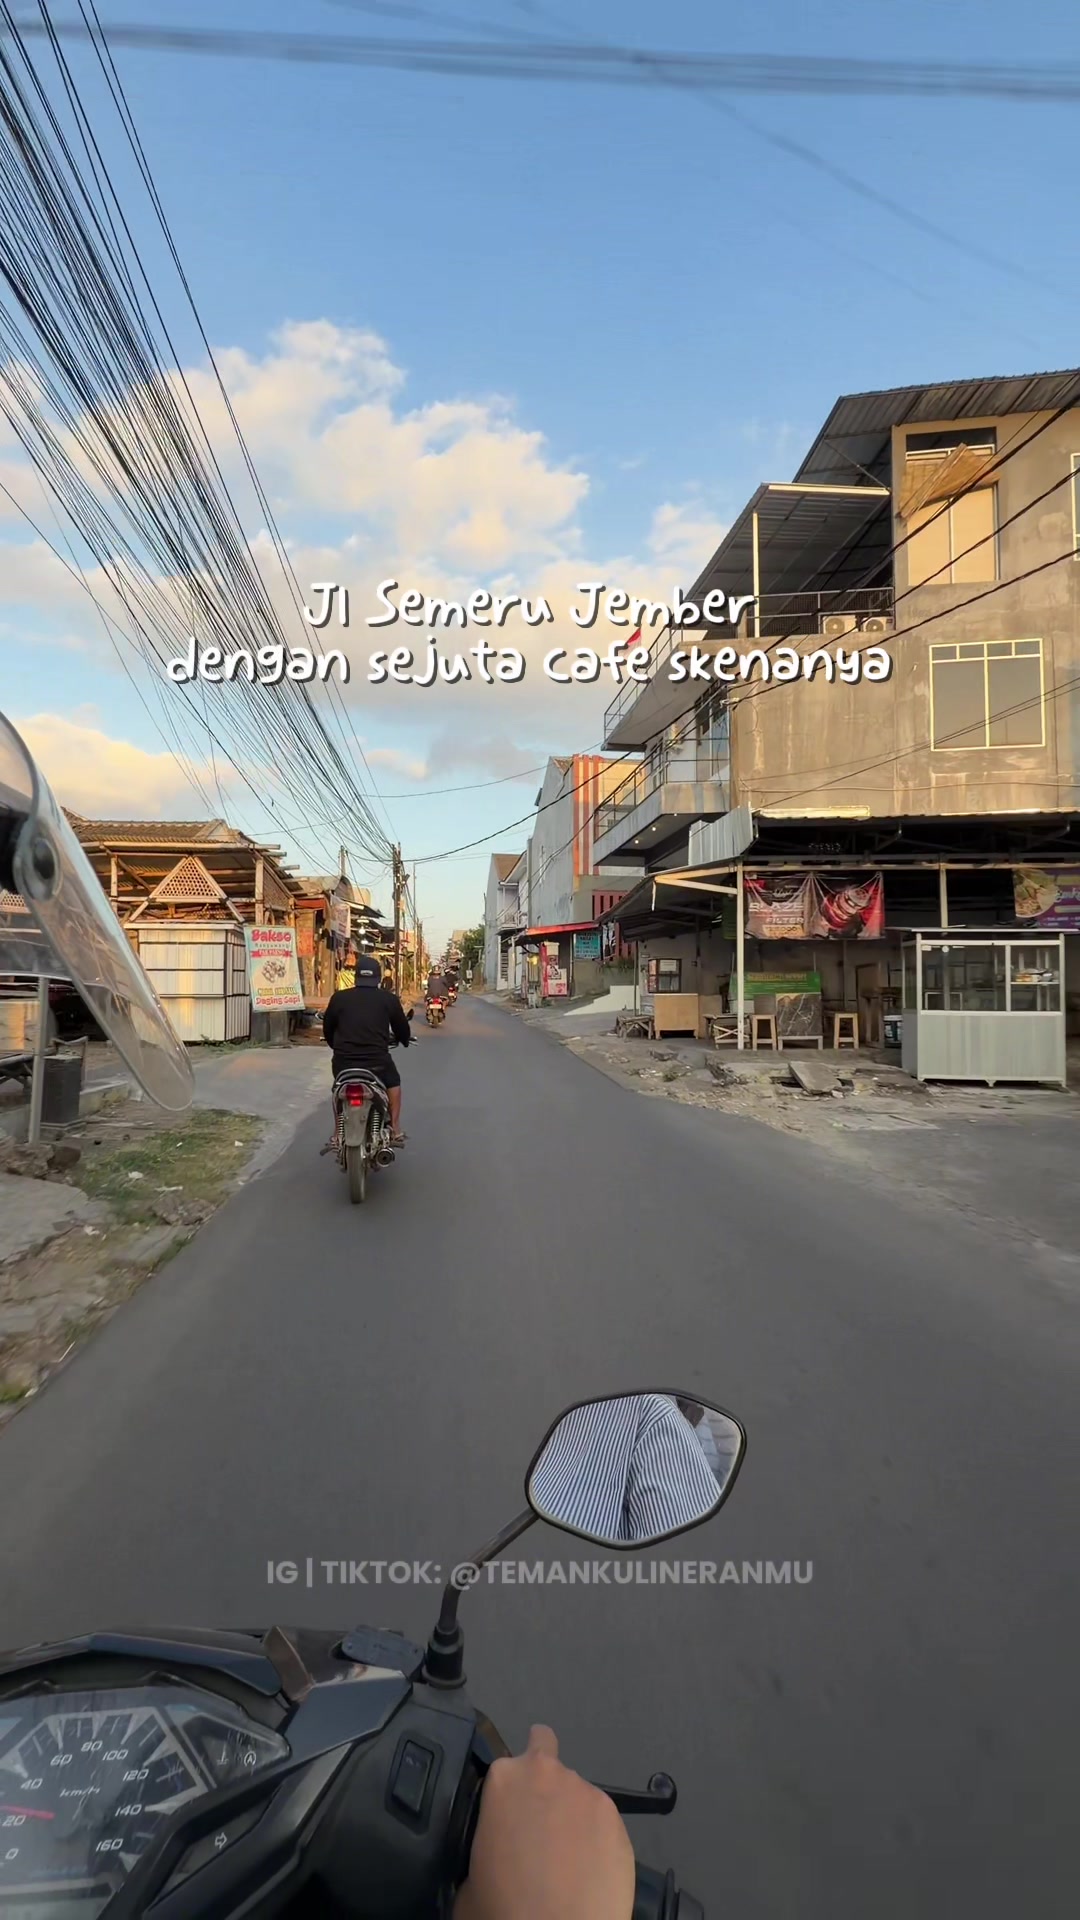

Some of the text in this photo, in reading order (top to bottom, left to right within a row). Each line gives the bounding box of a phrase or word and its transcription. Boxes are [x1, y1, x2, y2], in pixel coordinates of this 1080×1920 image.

[250, 928, 292, 942] Bakso
[81, 1739, 104, 1752] 80
[50, 1753, 73, 1766] 60
[102, 1749, 129, 1761] 100
[122, 1769, 149, 1782] 120
[20, 1777, 44, 1790] 40
[115, 1804, 143, 1817] 140
[2, 1814, 27, 1828] 20
[96, 1837, 124, 1853] 160
[5, 1847, 19, 1860] 0
